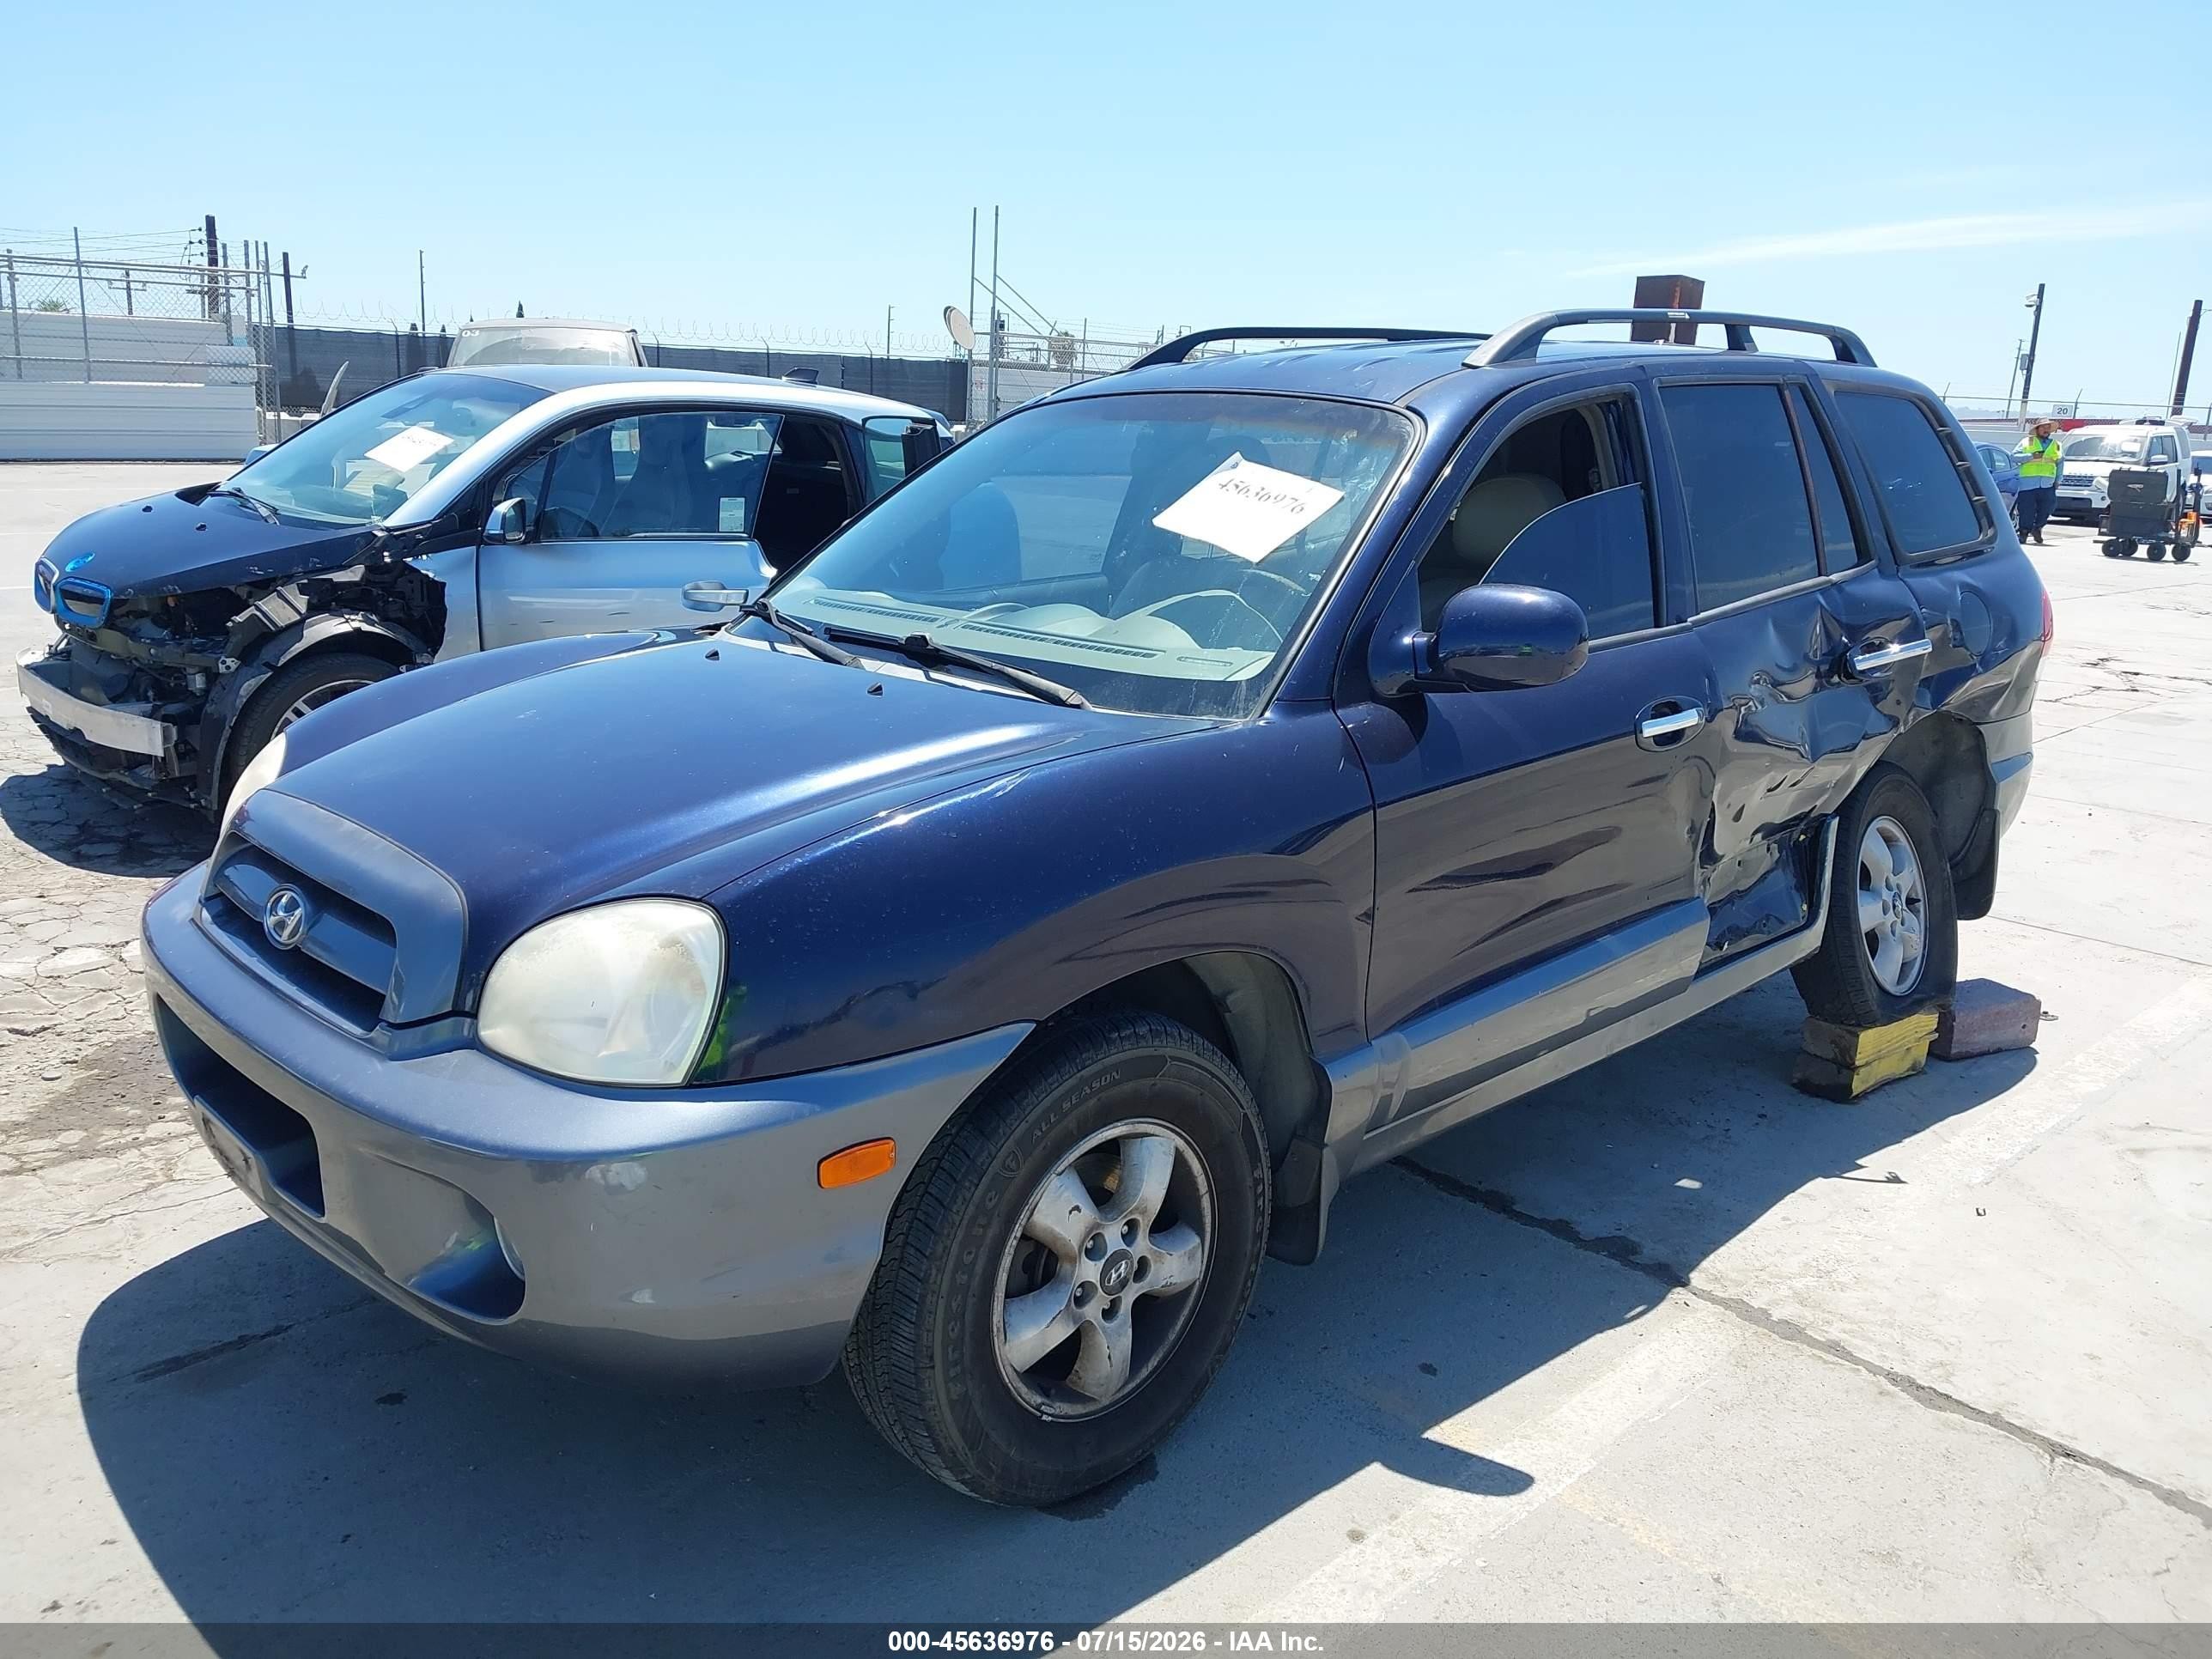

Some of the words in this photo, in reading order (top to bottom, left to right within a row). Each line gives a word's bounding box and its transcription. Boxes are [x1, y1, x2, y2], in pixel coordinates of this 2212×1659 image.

[1218, 477, 1306, 514] 45636976
[1032, 1112, 1059, 1145] ALL
[1061, 1068, 1121, 1113] SEASON
